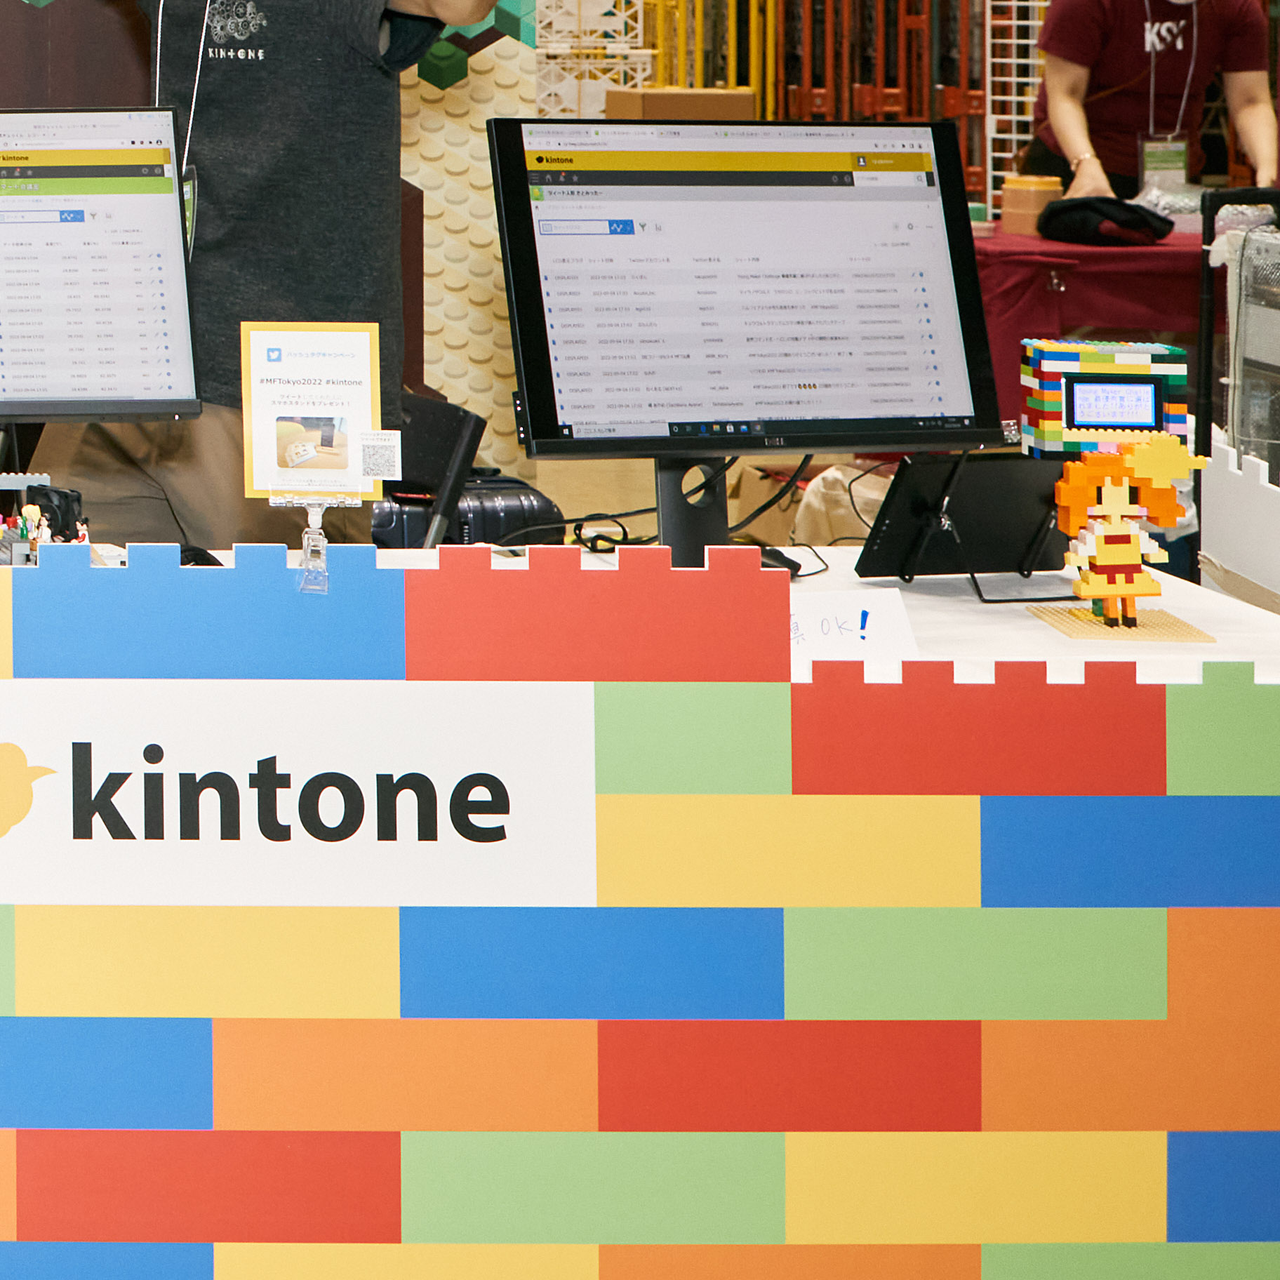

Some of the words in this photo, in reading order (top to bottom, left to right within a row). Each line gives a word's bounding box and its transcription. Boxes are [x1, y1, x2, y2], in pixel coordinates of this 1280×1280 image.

[2, 154, 29, 162] kintone
[545, 156, 574, 164] kintone
[259, 377, 323, 387] #MFTokyo2022
[325, 377, 363, 387] #kintone
[72, 742, 511, 843] kintone
